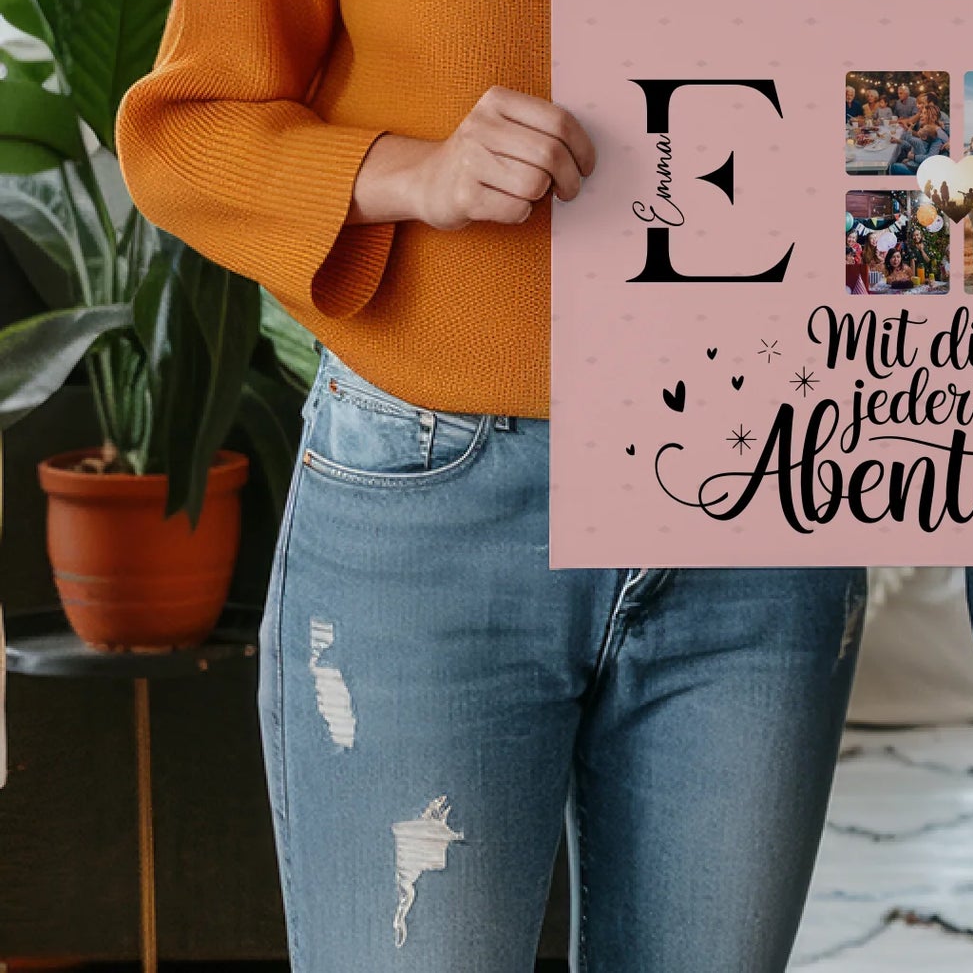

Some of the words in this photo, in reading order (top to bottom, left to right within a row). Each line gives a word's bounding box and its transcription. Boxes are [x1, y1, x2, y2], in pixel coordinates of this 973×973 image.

[626, 79, 795, 283] E
[631, 134, 685, 227] Emma
[807, 305, 927, 379] Mit
